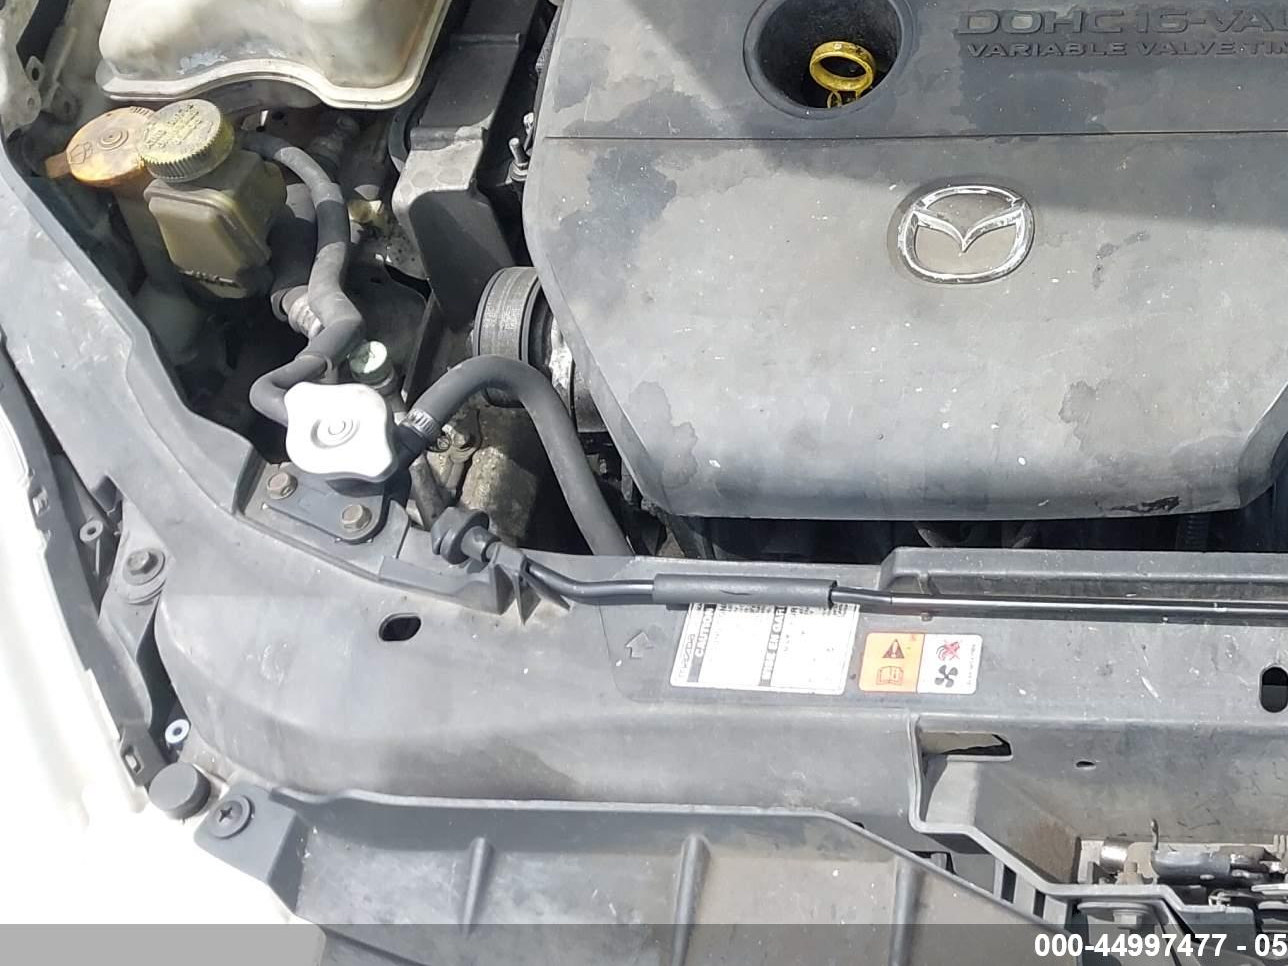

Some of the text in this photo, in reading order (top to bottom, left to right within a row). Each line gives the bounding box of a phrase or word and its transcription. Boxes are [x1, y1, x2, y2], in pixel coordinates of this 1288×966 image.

[955, 9, 1124, 35] DOHC
[967, 41, 1127, 58] VARIABLE
[1136, 41, 1236, 56] VALVE
[694, 607, 715, 658] CAUTION
[772, 607, 787, 633] GAR
